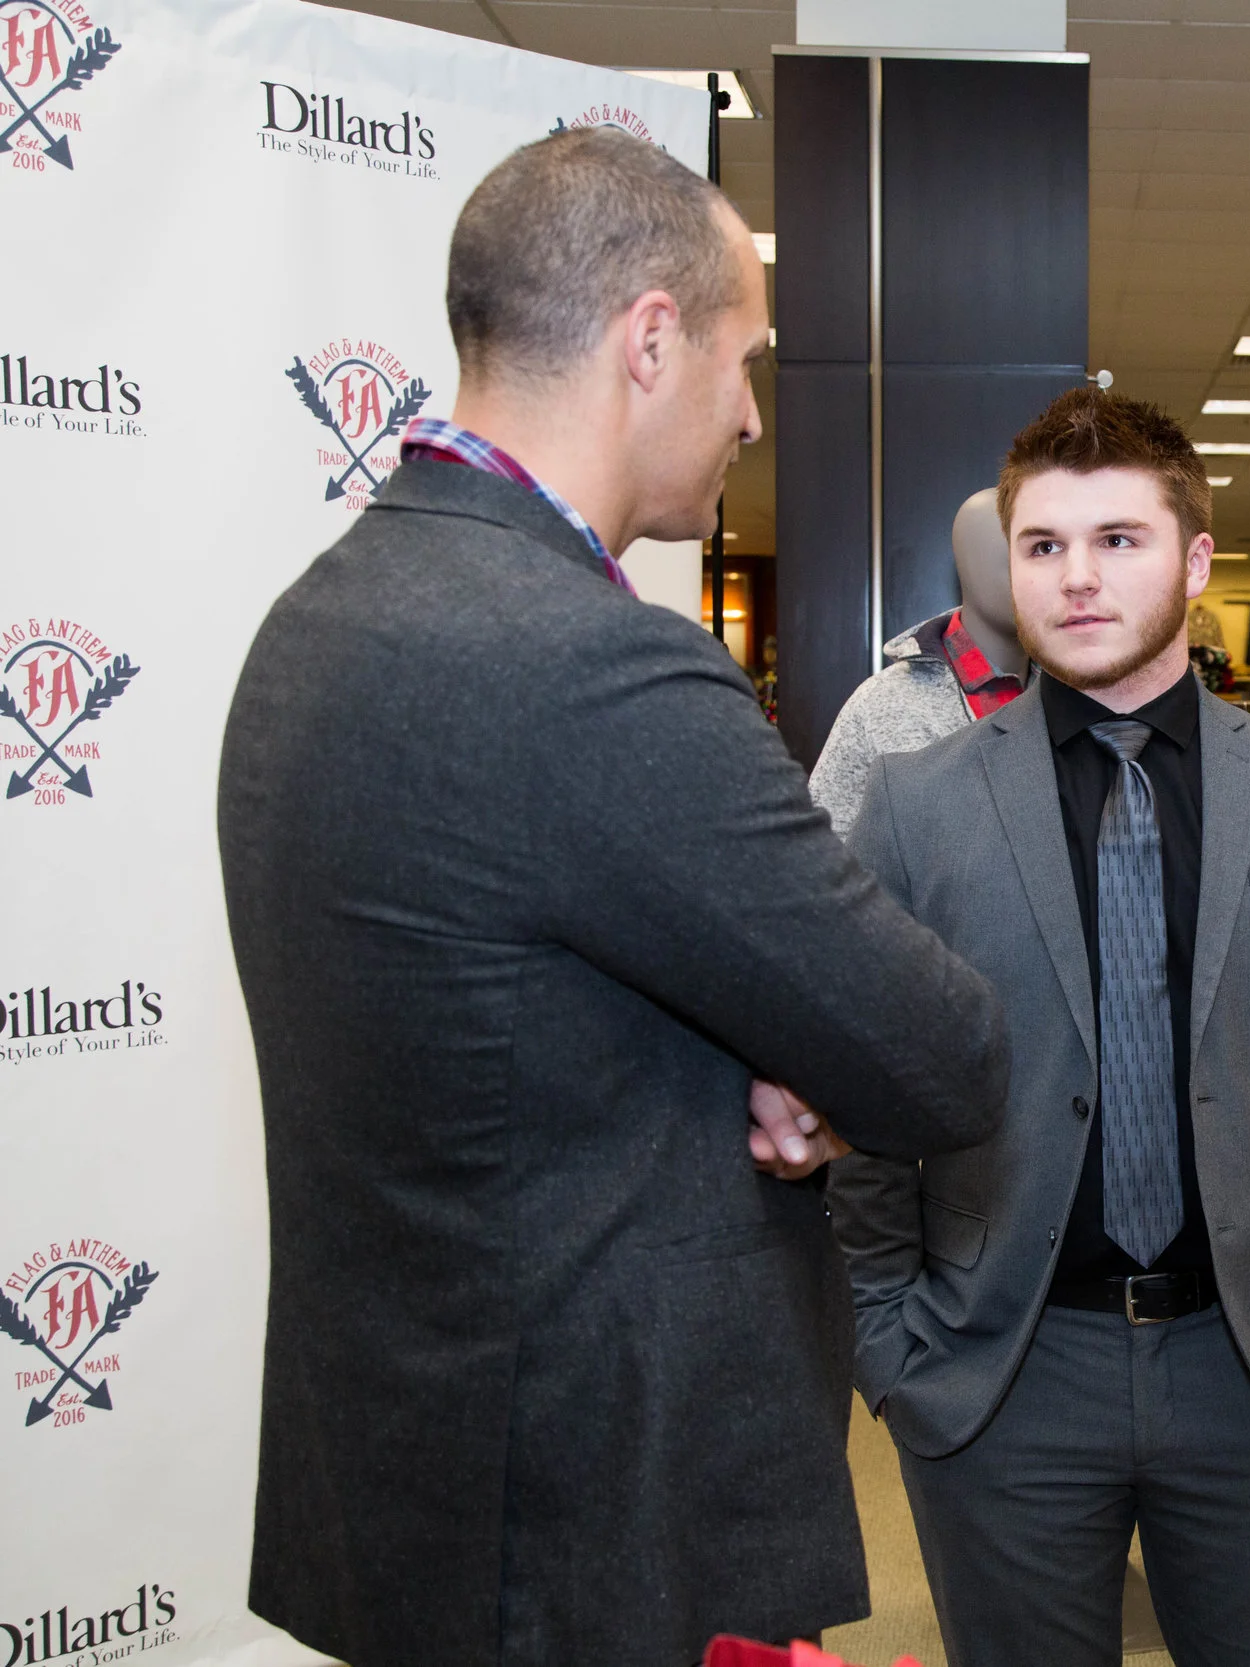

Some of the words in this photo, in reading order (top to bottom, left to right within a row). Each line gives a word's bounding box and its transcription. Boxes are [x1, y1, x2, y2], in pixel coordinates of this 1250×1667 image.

[45, 110, 82, 132] MARK
[260, 81, 435, 160] Dillard's
[603, 103, 611, 121] &
[613, 105, 653, 142] ANTHE
[16, 133, 43, 150] Est.
[256, 131, 291, 152] The
[297, 139, 336, 163] Style
[340, 150, 358, 165] of
[363, 152, 400, 174] Your
[406, 160, 441, 181] Life.
[13, 151, 45, 172] 2016
[309, 342, 340, 376] FLAG
[342, 338, 353, 356] &
[355, 339, 410, 385] ANTHEM
[0, 353, 141, 415] llard's
[335, 369, 383, 438] FA
[24, 412, 45, 429] of
[51, 413, 98, 433] Your
[104, 417, 147, 438] Life.
[316, 448, 348, 466] TRADE
[370, 455, 399, 471] MARK
[348, 480, 369, 493] Est.
[0, 624, 25, 662] LAG
[28, 618, 43, 638] &
[46, 617, 112, 665] ANTHEM
[19, 650, 80, 728] FA
[65, 741, 101, 760] MARK
[34, 788, 65, 806] 2016
[37, 771, 63, 786] Est.
[0, 979, 163, 1040] illard's
[47, 1038, 68, 1057] of
[74, 1035, 121, 1053] Your
[126, 1028, 169, 1049] Life.
[5, 1251, 47, 1293] FLAG
[49, 1243, 63, 1261] &
[66, 1238, 132, 1277] ANTHEM
[40, 1269, 100, 1349] FA
[15, 1368, 57, 1391] TRADE
[84, 1353, 121, 1374] MARK
[53, 1407, 86, 1428] 2016
[57, 1392, 83, 1408] Est.
[91, 1643, 135, 1667] Your
[140, 1627, 181, 1653] Life.
